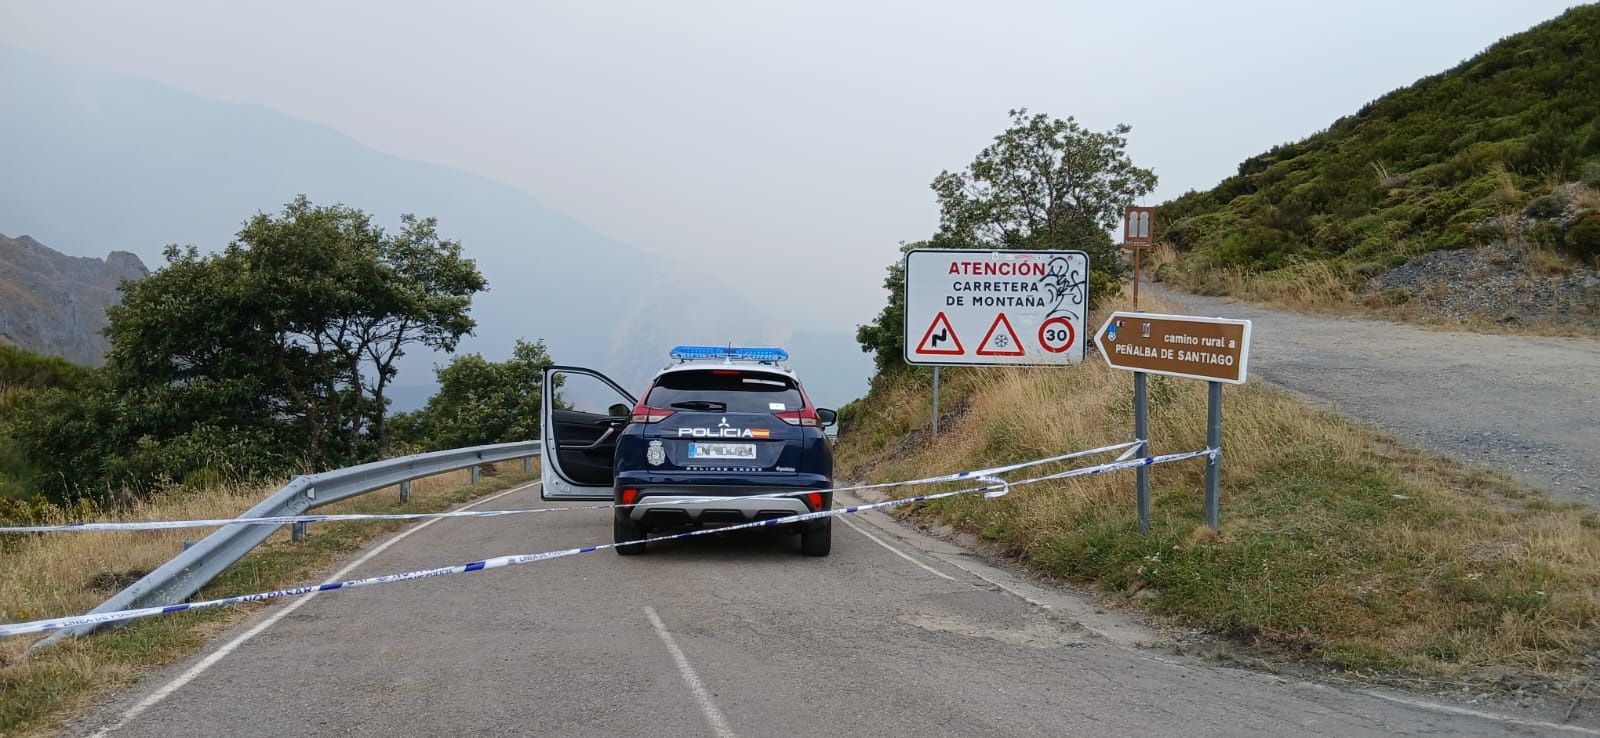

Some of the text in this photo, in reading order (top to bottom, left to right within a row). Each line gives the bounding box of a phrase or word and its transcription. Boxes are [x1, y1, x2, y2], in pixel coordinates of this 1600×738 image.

[949, 260, 1046, 276] ATENCIÓN
[953, 281, 1039, 292] CARRETERA
[946, 295, 1045, 307] DE MONTAÑA
[1045, 329, 1067, 341] 30
[1164, 334, 1236, 349] camino rural a
[1115, 343, 1233, 366] PEÑALBA DE SANTIAGO
